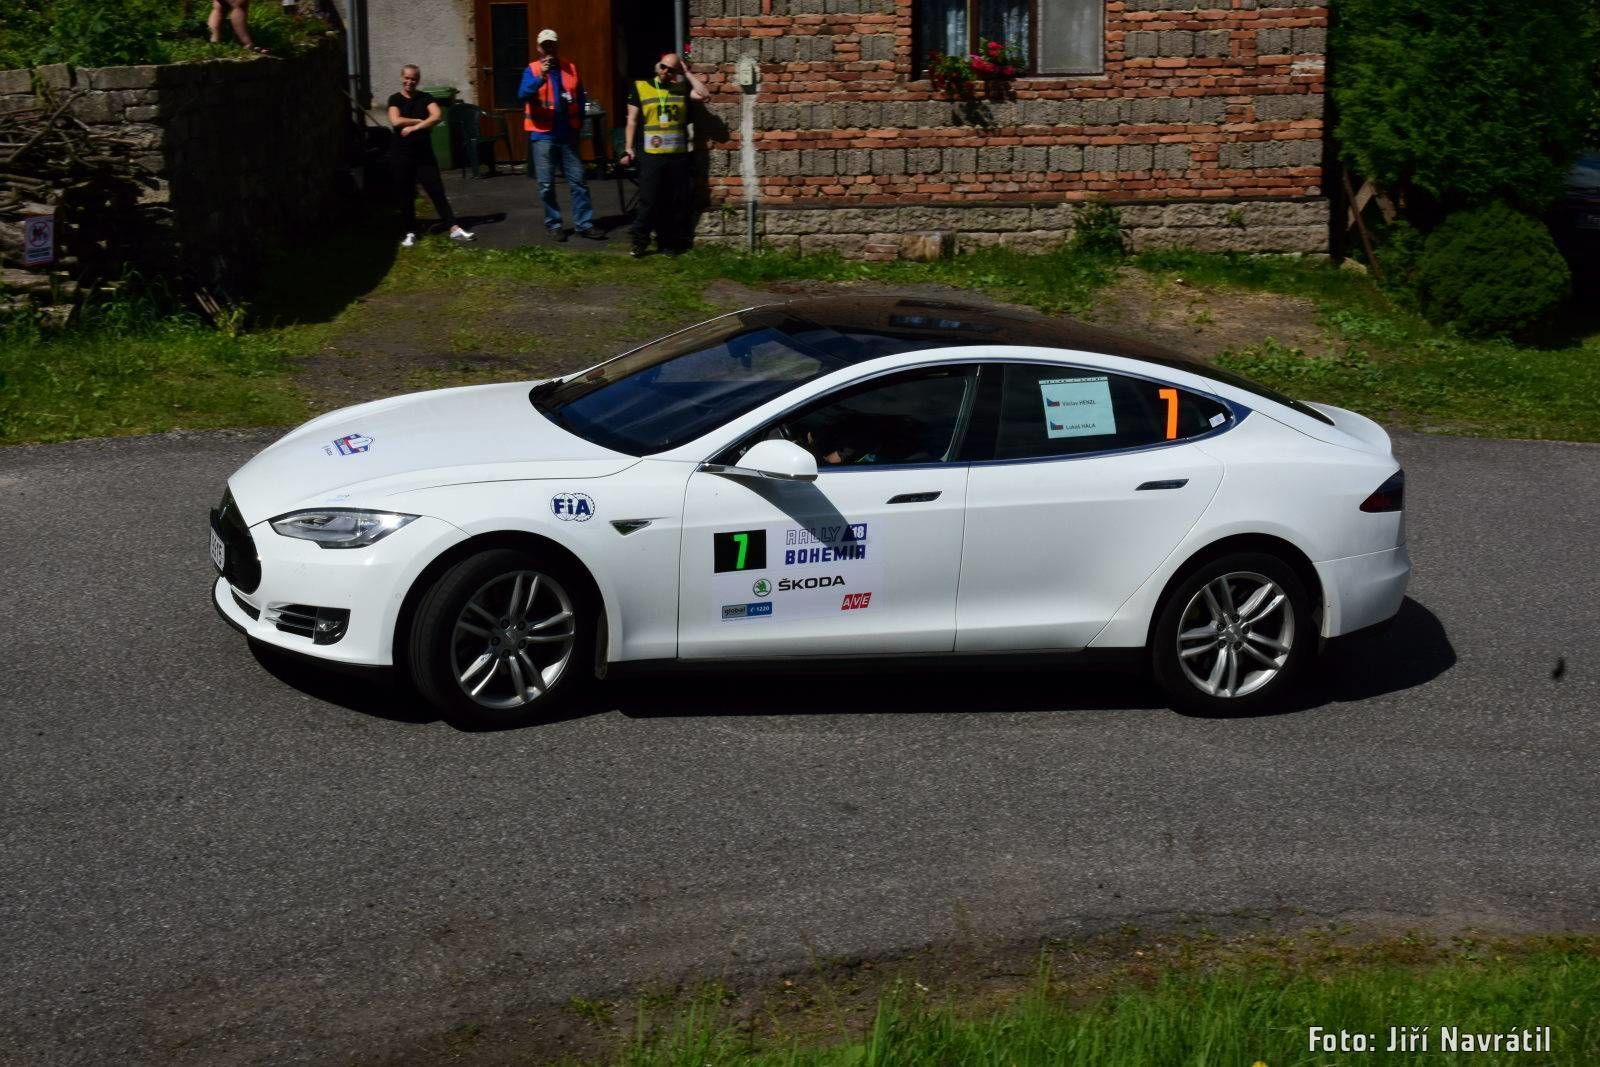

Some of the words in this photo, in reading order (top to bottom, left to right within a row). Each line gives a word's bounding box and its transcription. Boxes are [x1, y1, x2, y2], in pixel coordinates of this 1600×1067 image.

[1158, 388, 1178, 440] 7
[786, 525, 840, 546] RALLY
[851, 525, 865, 539] 18
[733, 533, 748, 570] 7
[785, 544, 866, 565] BOHEMIA
[778, 575, 846, 592] ŠKODA
[841, 592, 872, 611] AVE
